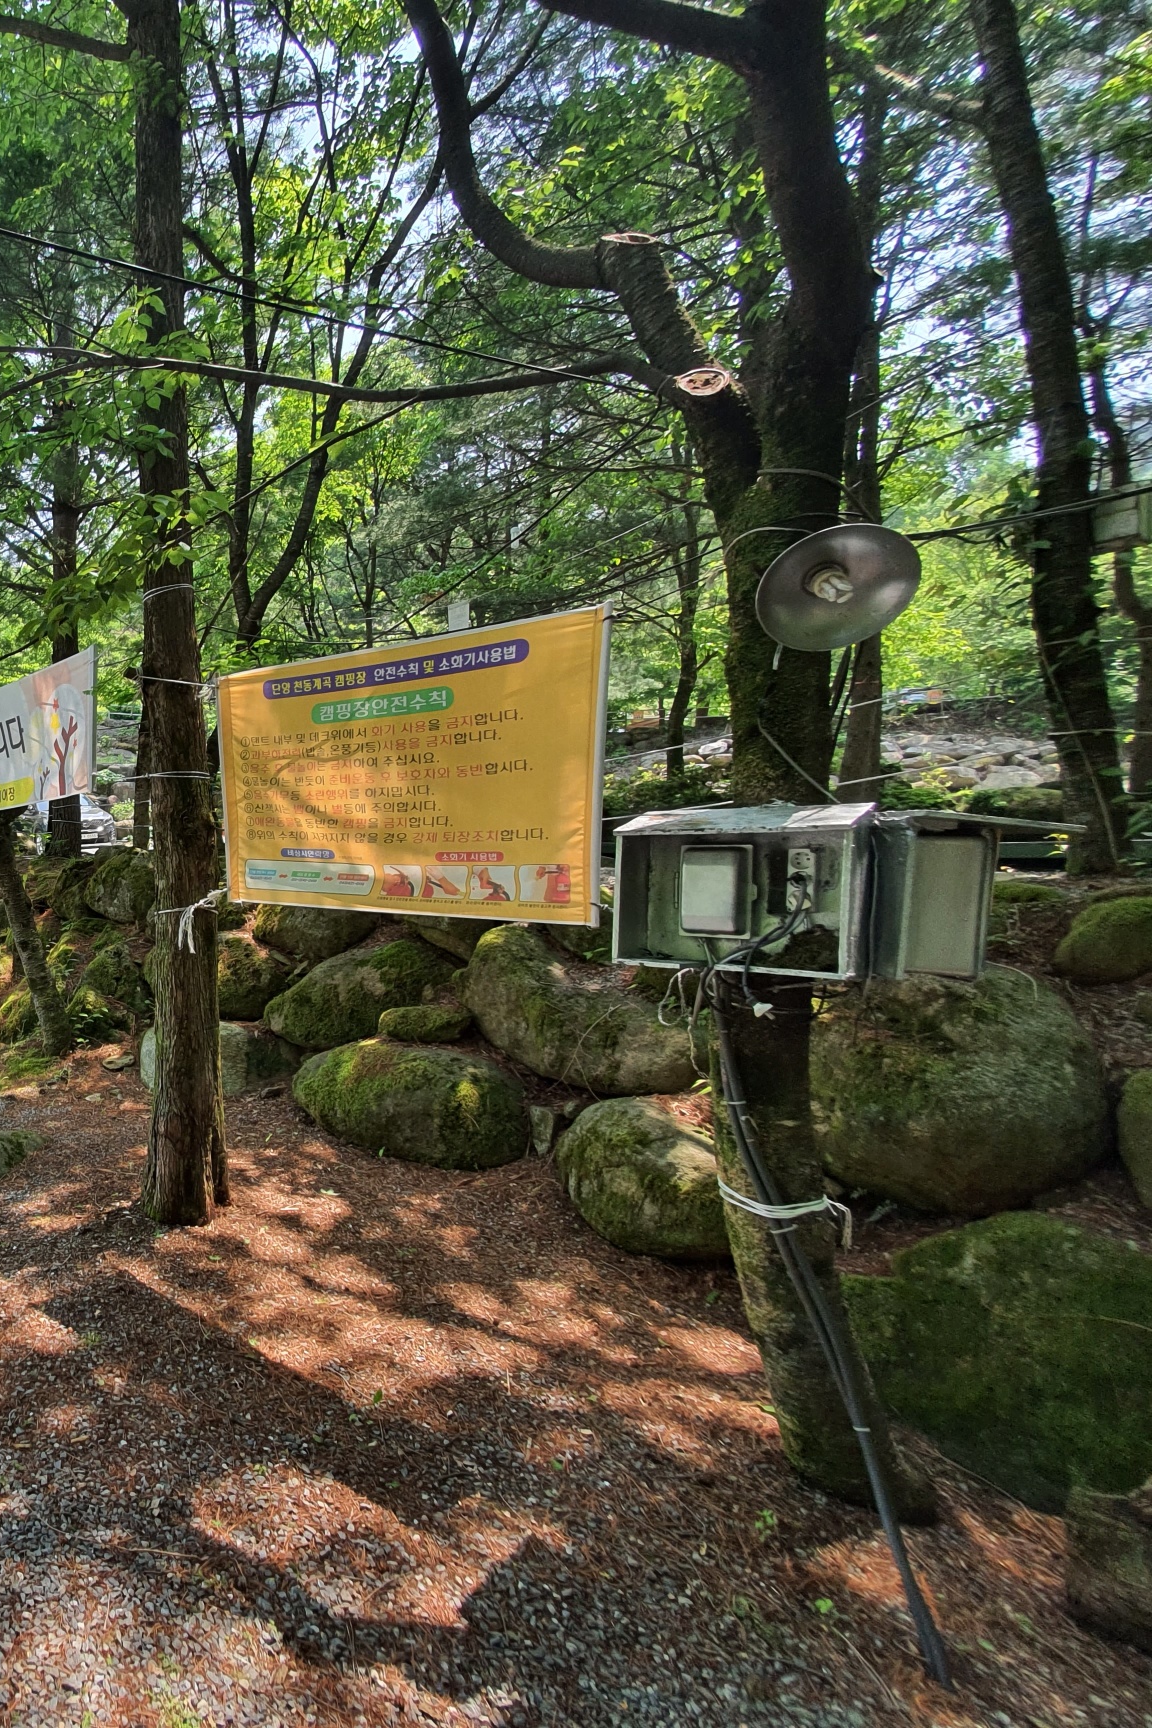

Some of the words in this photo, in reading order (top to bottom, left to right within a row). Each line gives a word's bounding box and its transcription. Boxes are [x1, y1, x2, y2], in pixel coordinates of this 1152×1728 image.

[271, 681, 290, 695] 단양
[293, 676, 332, 693] 천동계곡
[334, 671, 366, 688] 캠핑장
[373, 662, 419, 682] 안전수칙
[423, 659, 435, 674] 및
[438, 644, 517, 671] 소화기사용법
[319, 690, 448, 722] 캠핑장안전수칙
[273, 734, 293, 746] 내부
[296, 733, 306, 744] 및
[309, 728, 367, 742] 데크위에서
[371, 724, 395, 736] 화기
[400, 718, 440, 734] 사용을
[446, 708, 524, 729] 금지합니다.
[425, 729, 502, 748] 금지합니다.
[330, 756, 378, 771] 금지하여
[383, 752, 440, 767] 주십시요.
[294, 774, 325, 786] 반듯이
[329, 772, 375, 785] 준비운동
[380, 771, 391, 783] 후
[396, 767, 450, 782] 보호자와
[456, 759, 534, 778] 동반합시다.
[305, 788, 360, 801] 소란행위를
[365, 785, 435, 798] 하지맙시다.
[332, 802, 366, 814] 벌등에
[371, 800, 442, 813] 주의합시다.
[305, 818, 338, 829] 동반한
[343, 818, 378, 829] 캠핑을
[383, 815, 453, 829] 금지합니다.
[278, 830, 309, 841] 수칙이
[354, 832, 379, 844] 않을
[383, 832, 407, 844] 경우
[412, 831, 438, 844] 강제
[442, 827, 549, 844] 퇴장조치합니다.
[441, 852, 467, 861] 소화기
